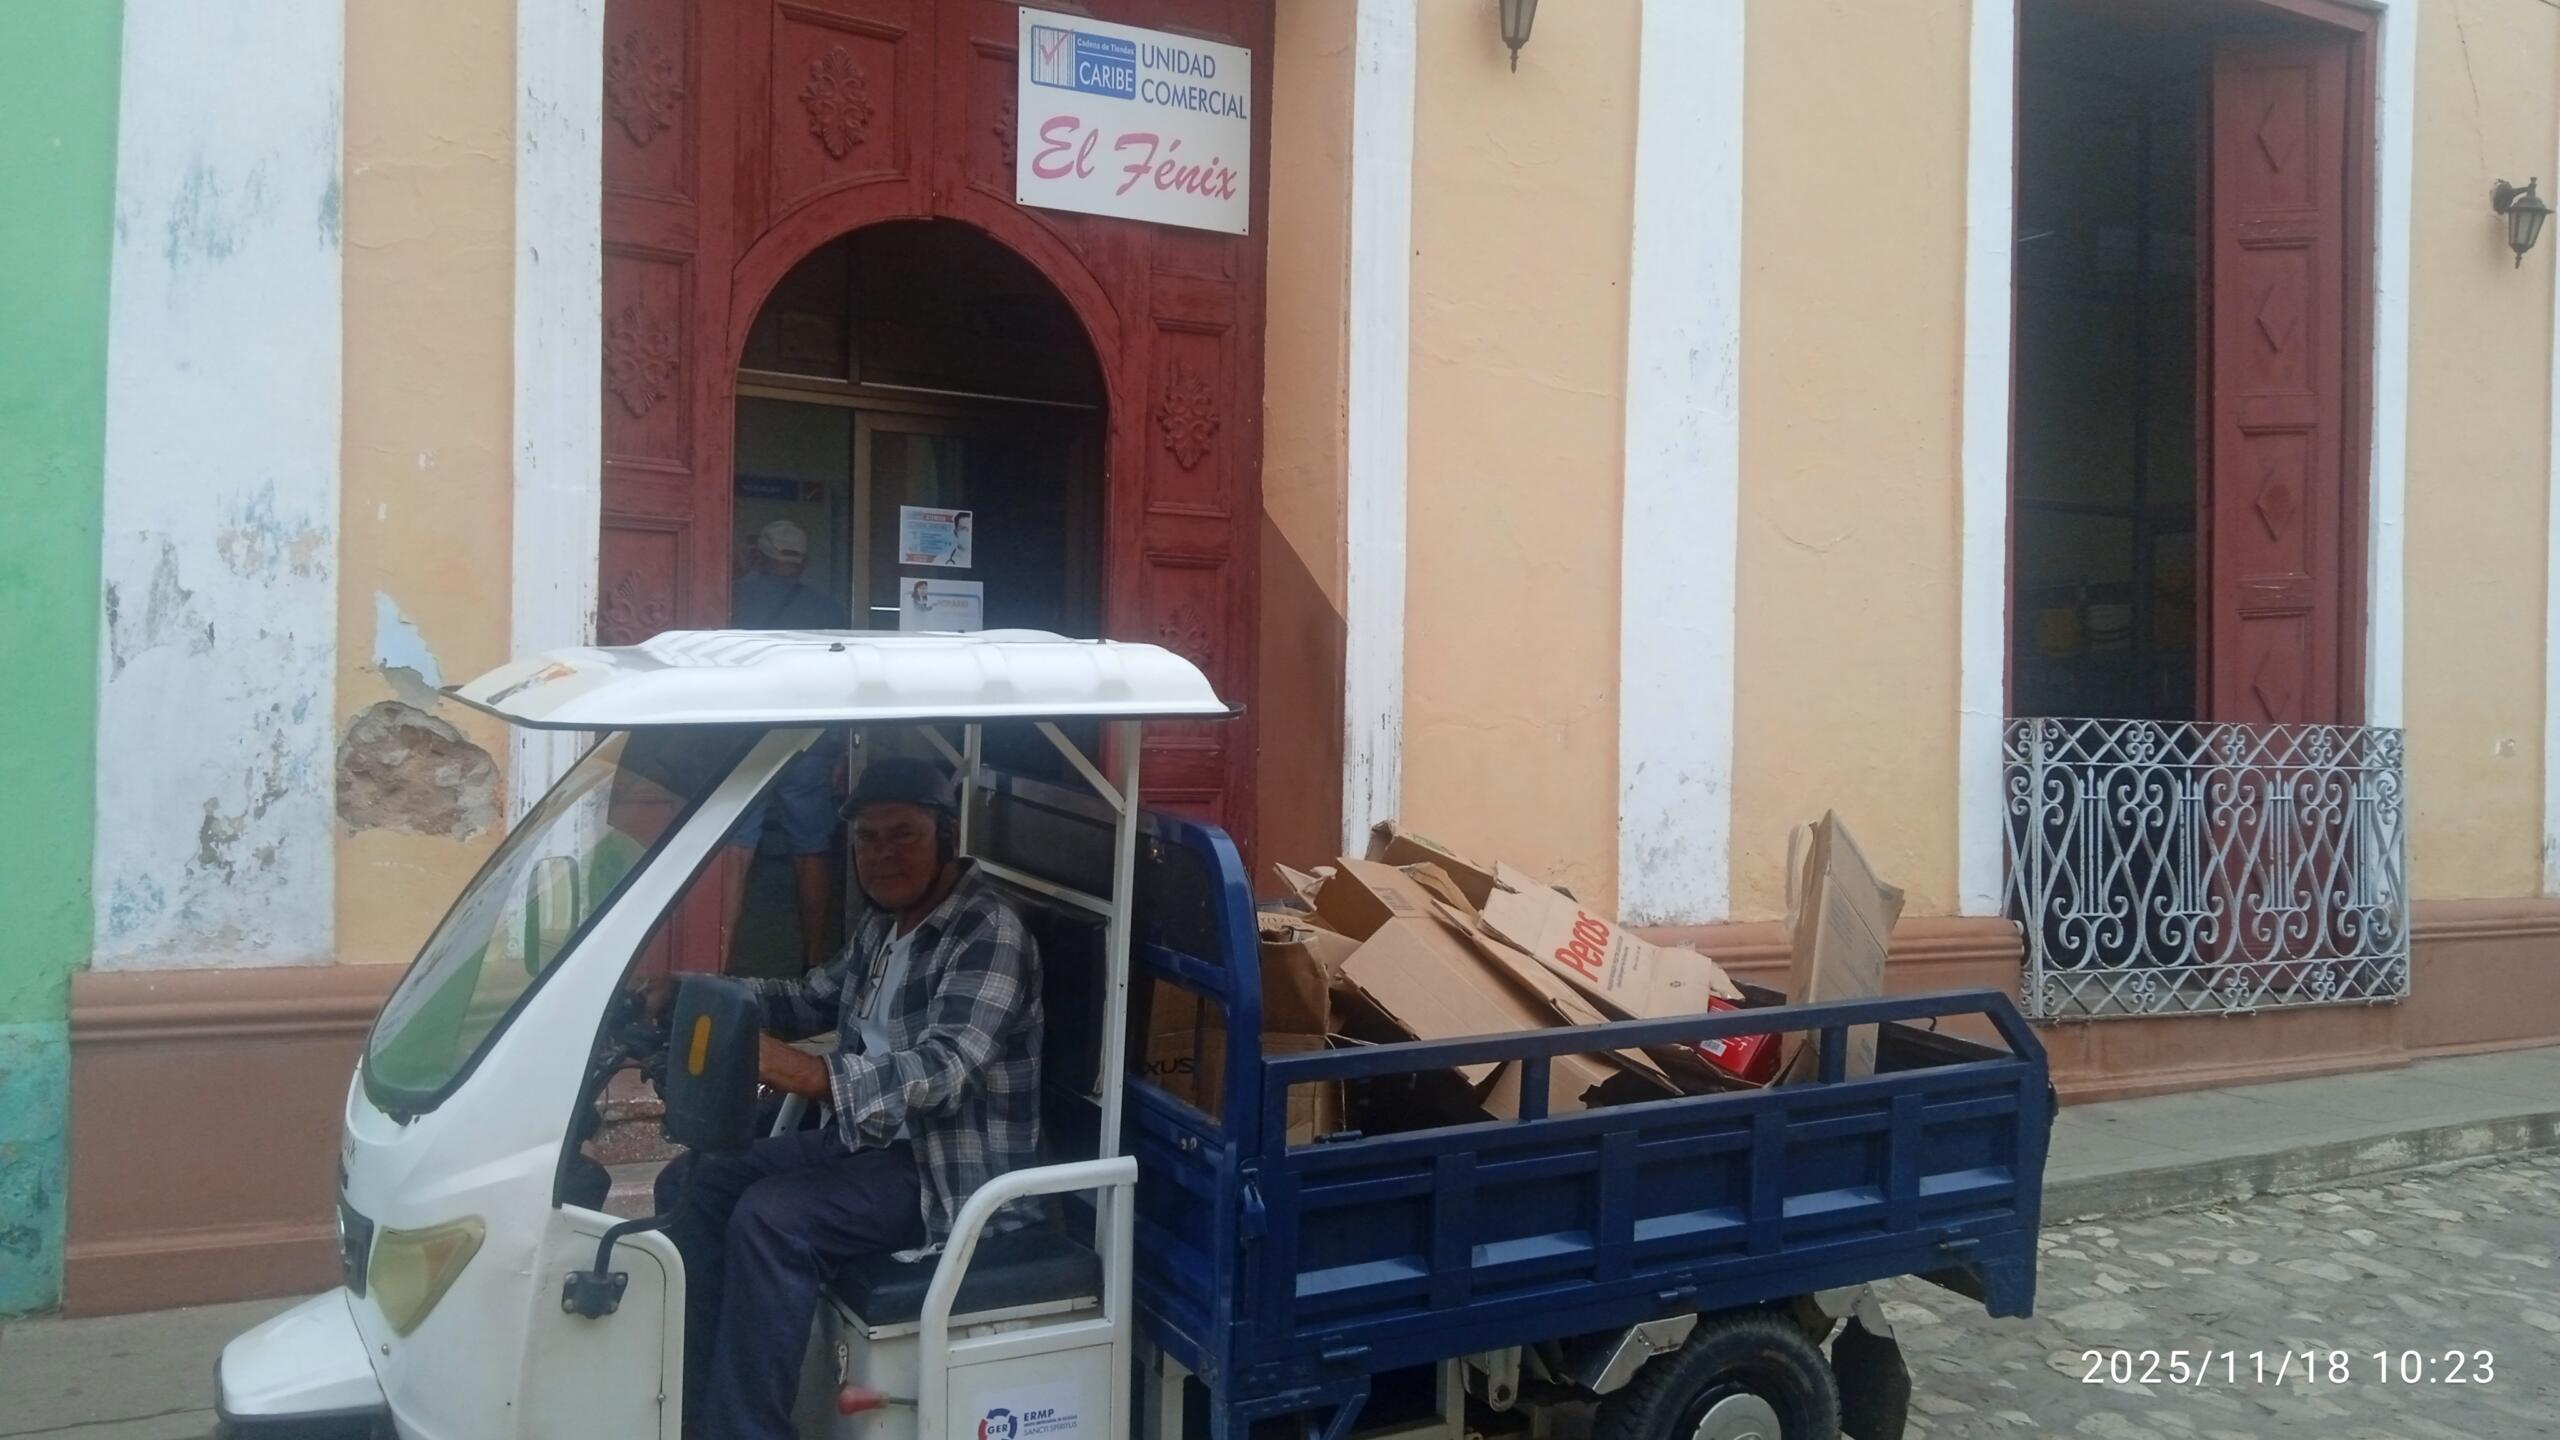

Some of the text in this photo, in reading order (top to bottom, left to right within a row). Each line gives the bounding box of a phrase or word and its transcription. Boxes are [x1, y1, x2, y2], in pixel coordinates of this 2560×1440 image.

[1076, 37, 1135, 56] Cadena de Tiendas
[1141, 43, 1216, 79] UNIDAD
[1079, 61, 1134, 92] CARIBE
[1141, 78, 1248, 120] COMERCIAL
[1031, 115, 1238, 201] El Fénix
[1554, 910, 1610, 983] Peros
[987, 1423, 1009, 1435] GER
[1023, 1408, 1055, 1422] ERMP
